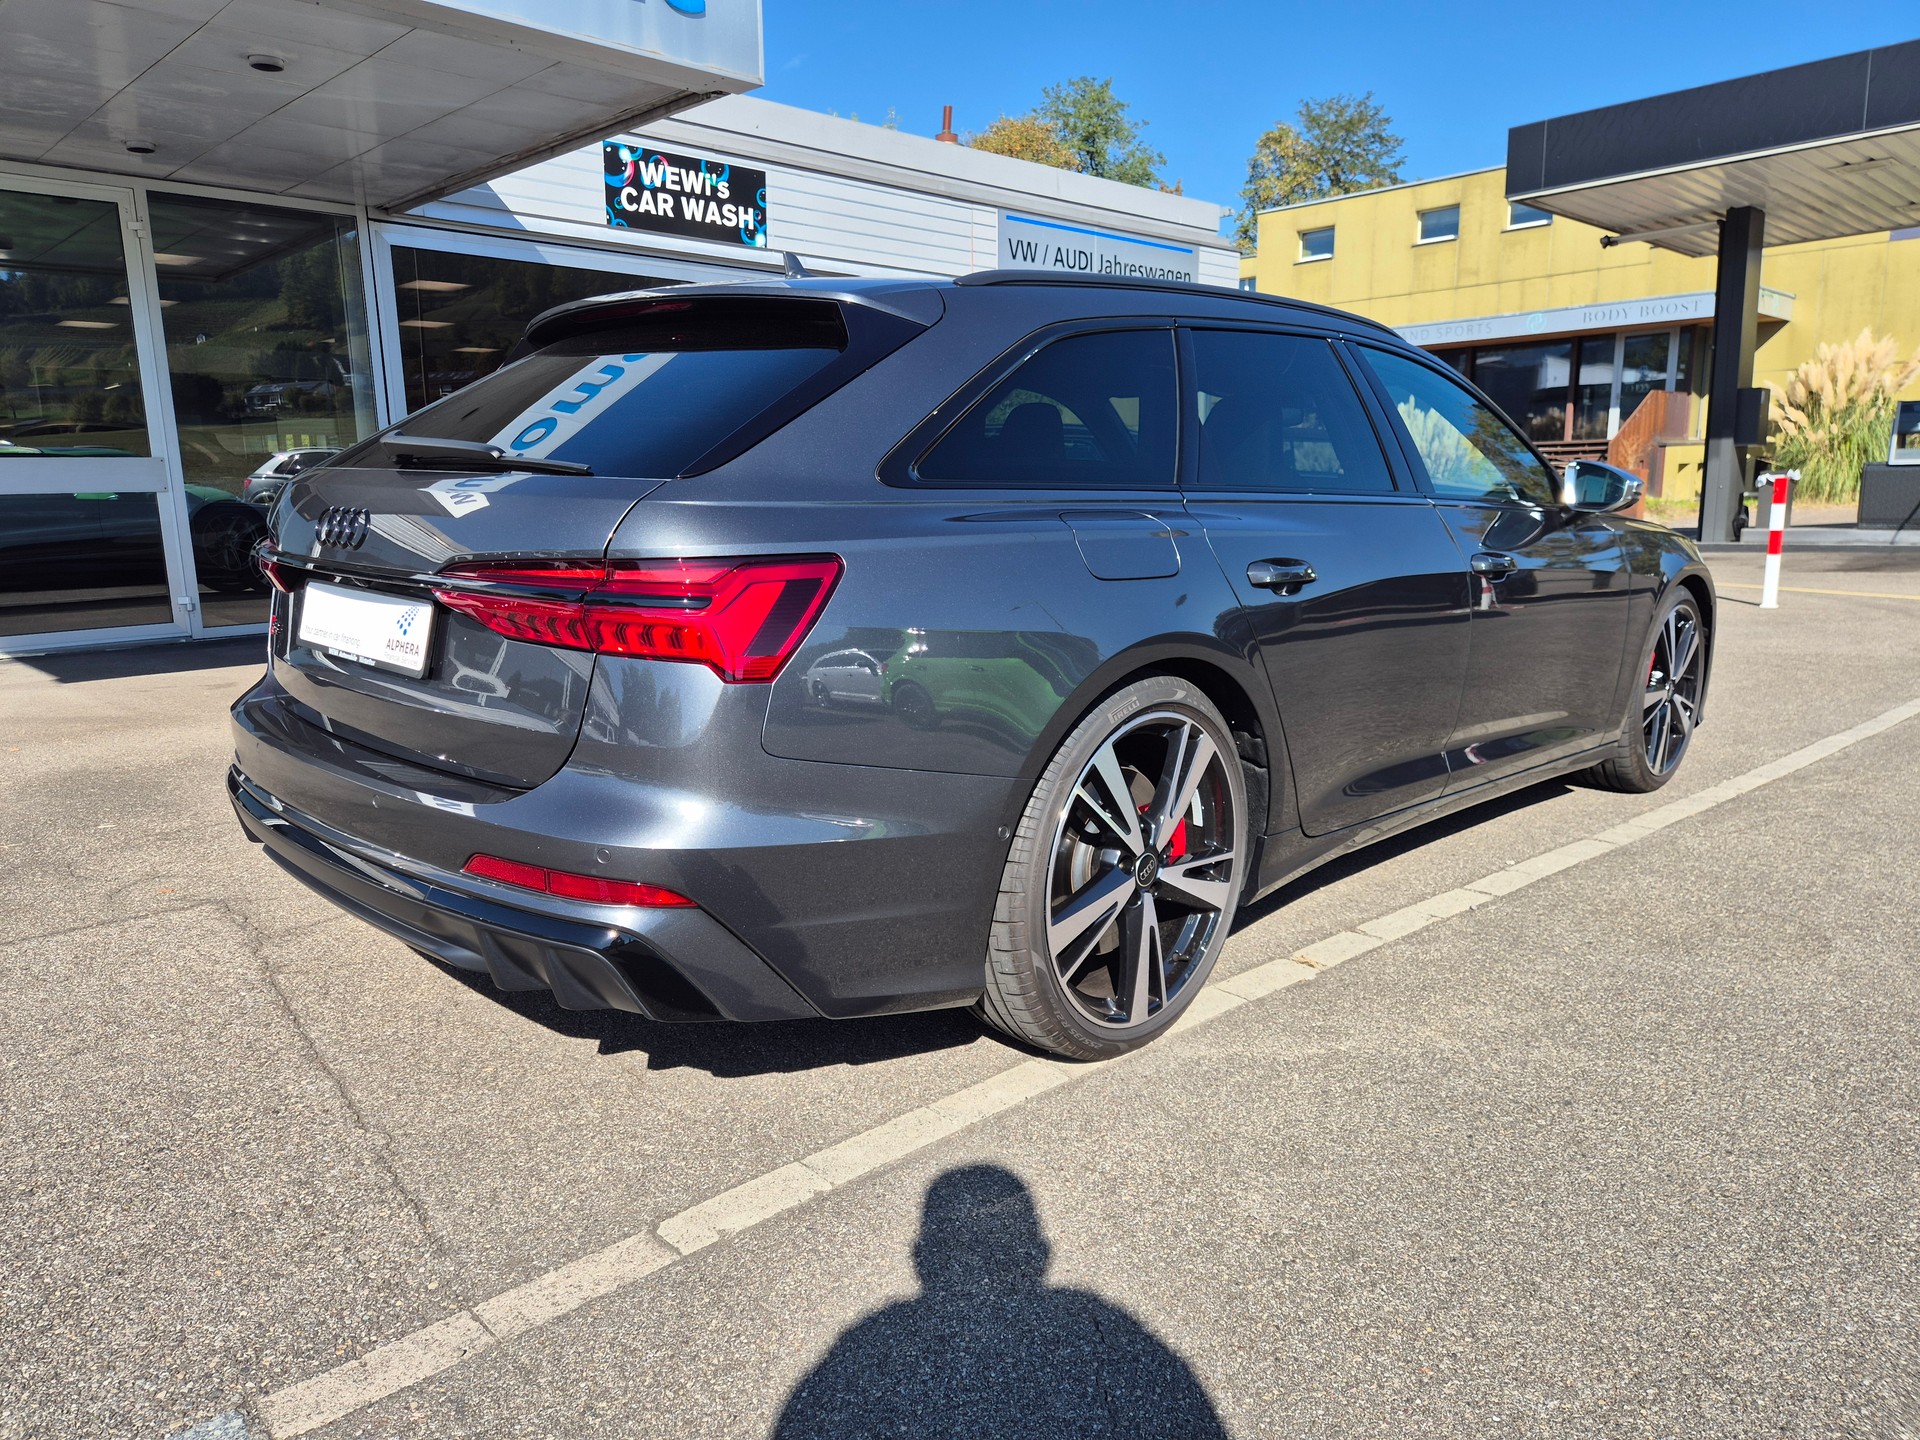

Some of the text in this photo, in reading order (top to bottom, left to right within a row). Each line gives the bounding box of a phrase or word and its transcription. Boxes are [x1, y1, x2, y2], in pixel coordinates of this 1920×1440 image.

[639, 161, 730, 199] WEWi's
[620, 186, 754, 230] CAR WASH
[1008, 237, 1038, 263] VW
[1053, 247, 1093, 272] AUDI
[1583, 300, 1702, 323] BODY BOOST
[1437, 322, 1493, 338] SPORTS
[385, 638, 419, 657] ALPHERA
[1107, 696, 1140, 724] PIRELLI
